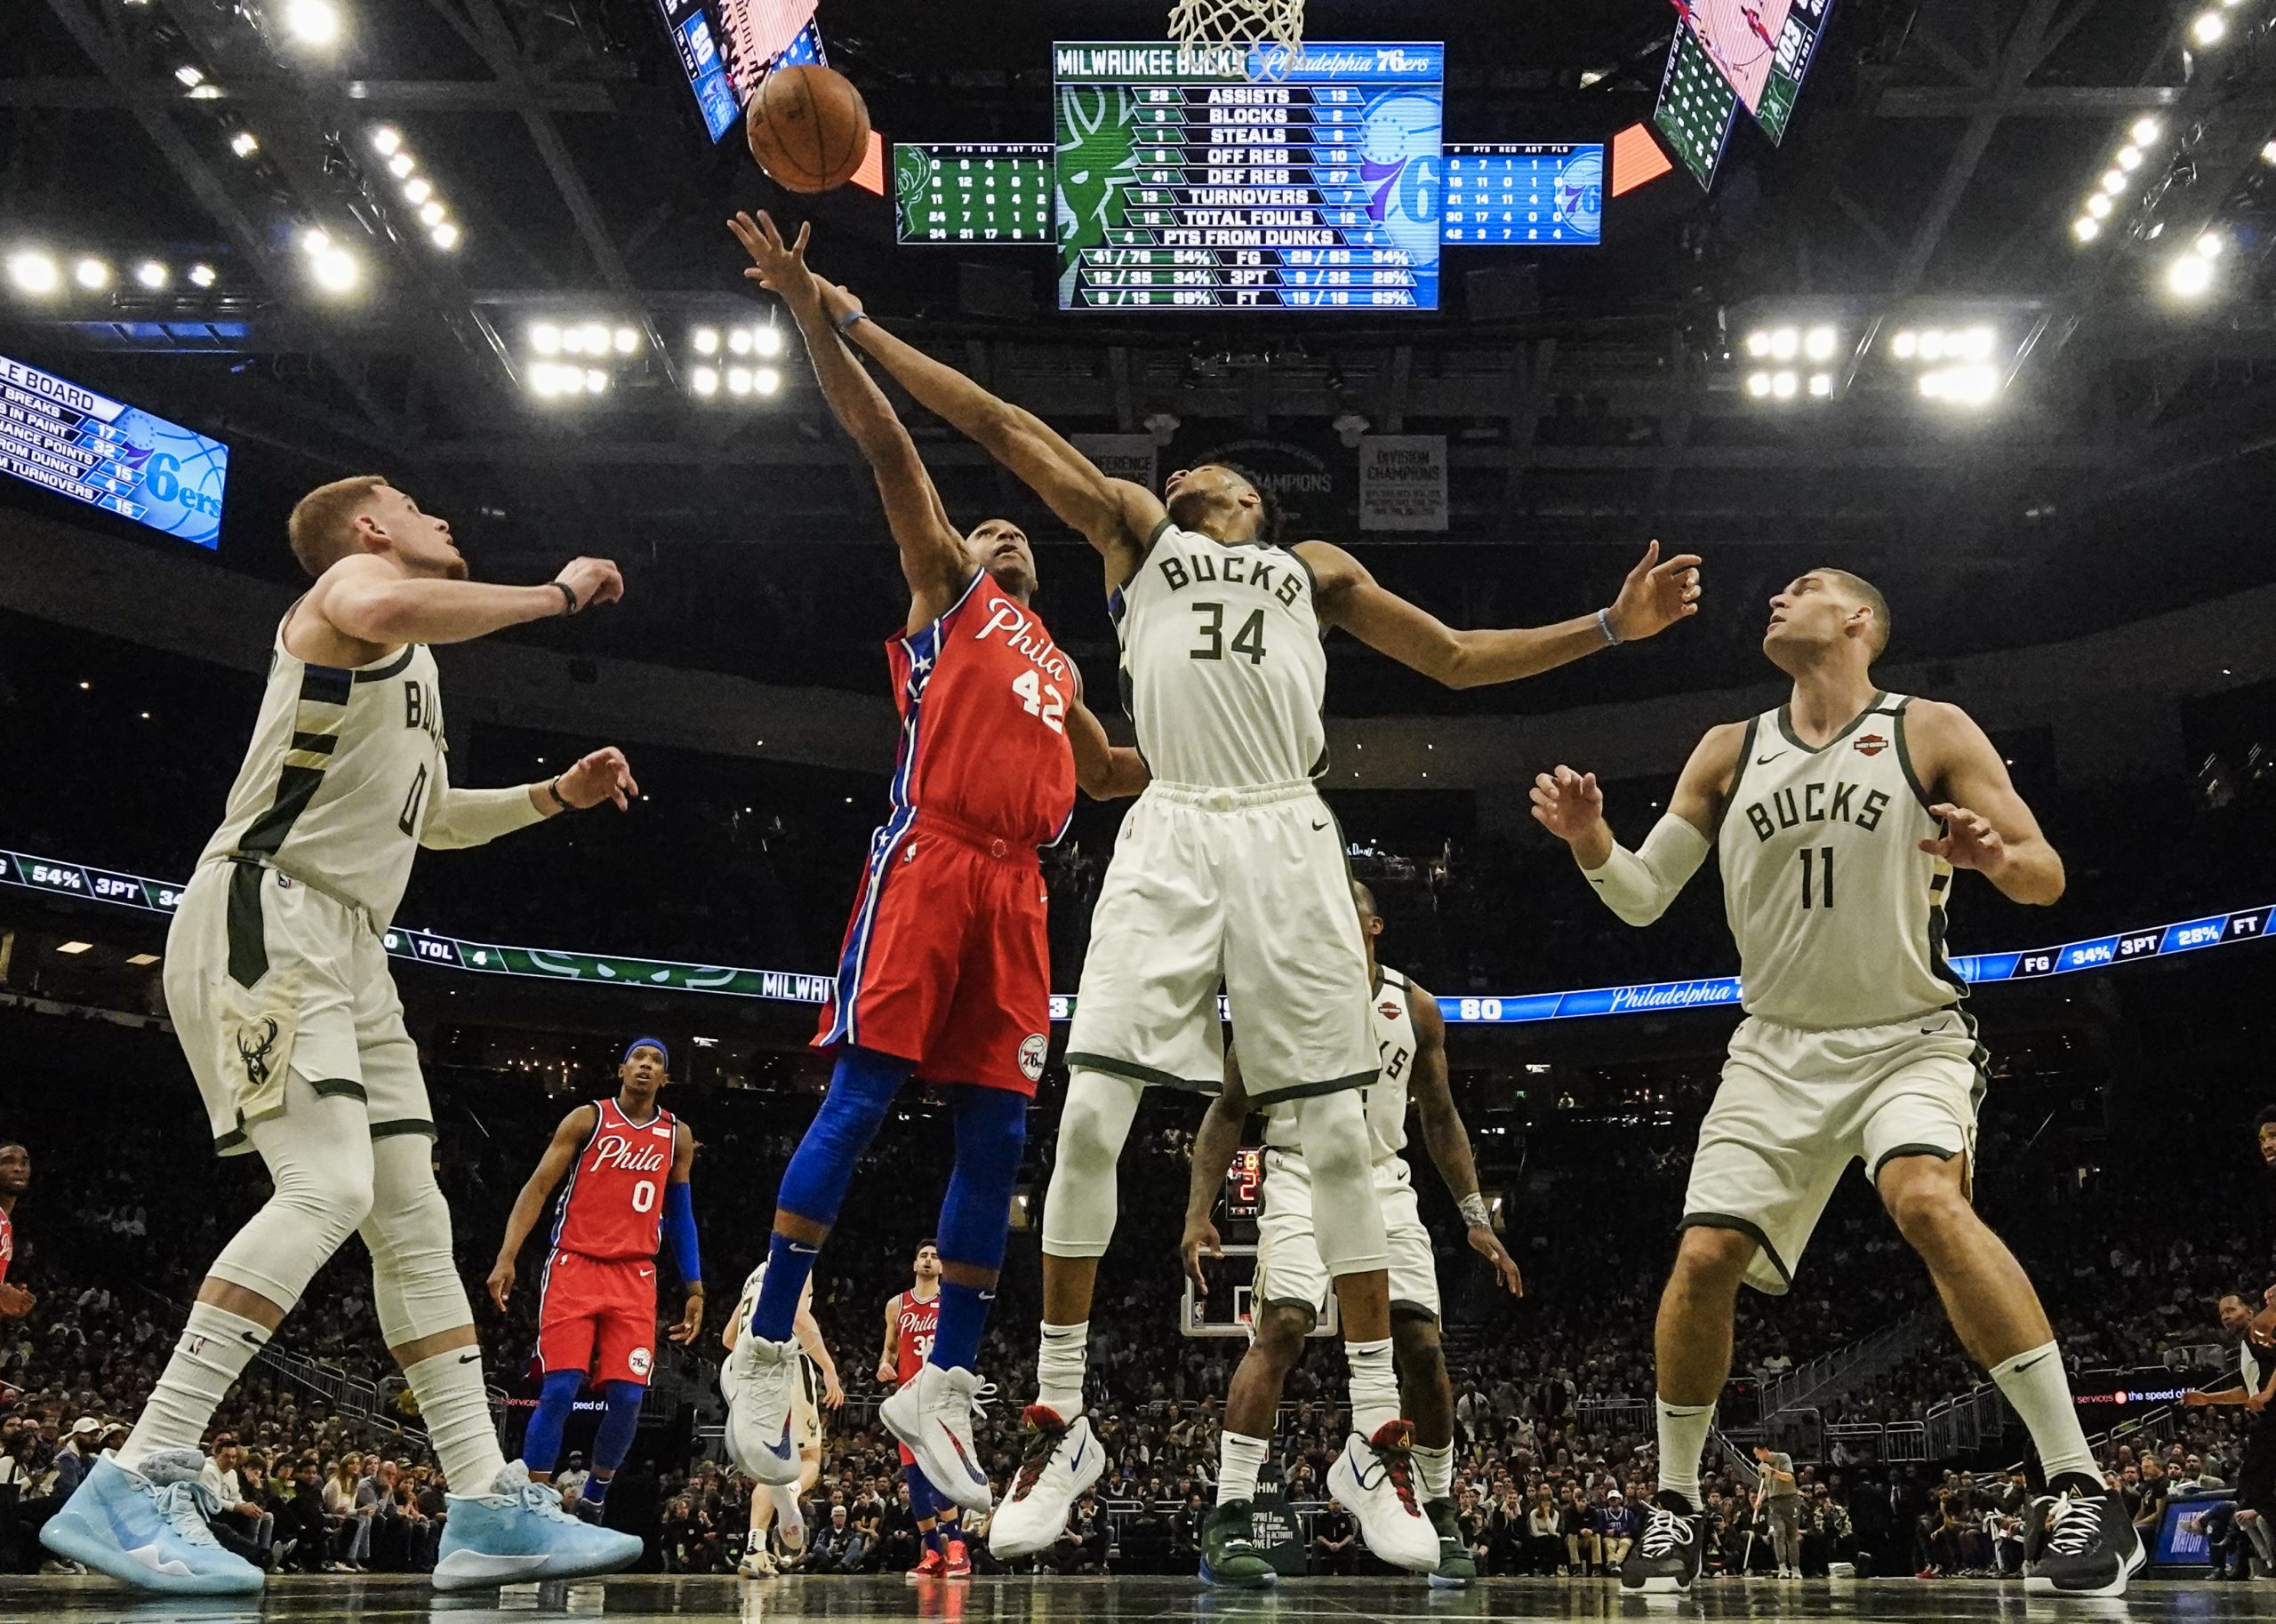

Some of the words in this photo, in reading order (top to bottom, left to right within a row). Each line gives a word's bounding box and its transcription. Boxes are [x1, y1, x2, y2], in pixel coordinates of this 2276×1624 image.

[691, 22, 715, 65] 80
[1775, 18, 1801, 73] 103
[1057, 50, 1173, 76] MILWAUKEE
[1377, 49, 1429, 72] 76ers
[1207, 89, 1289, 103] ASSISTS
[1330, 90, 1348, 101] 13
[1155, 109, 1166, 122] 3
[1209, 108, 1287, 124] BLOCKS
[1333, 109, 1342, 122] 2
[1157, 130, 1164, 141] 1
[1211, 128, 1286, 143] STEALS
[1207, 148, 1245, 164] OFF
[1249, 148, 1288, 164] REB
[1330, 150, 1347, 162] 10
[931, 159, 941, 170] 0
[985, 159, 994, 170] 4
[1012, 159, 1019, 170] 1
[1038, 159, 1044, 170] 1
[1450, 159, 1460, 170] 0
[1479, 159, 1487, 170] 7
[1505, 159, 1511, 170] 1
[1531, 159, 1538, 170] 1
[1556, 159, 1563, 170] 1
[958, 177, 973, 188] 12
[985, 177, 995, 188] 4
[1038, 177, 1044, 188] 1
[1151, 171, 1168, 182] 41
[1207, 169, 1245, 184] DEF
[1250, 169, 1289, 184] REB
[1330, 171, 1348, 182] 27
[1477, 177, 1488, 188] 11
[1503, 177, 1513, 188] 0
[1531, 177, 1537, 188] 1
[931, 194, 942, 204] 11
[962, 194, 970, 204] 7
[1012, 194, 1021, 204] 4
[1037, 194, 1046, 204] 2
[1141, 191, 1158, 203] 13
[1189, 189, 1309, 204] TURNOVERS
[1342, 191, 1352, 203] 7
[1447, 194, 1462, 204] 21
[1475, 194, 1489, 204] 14
[1502, 194, 1512, 204] 11
[1529, 194, 1538, 204] 4
[929, 211, 946, 222] 24
[962, 211, 971, 222] 7
[988, 211, 994, 222] 1
[1014, 211, 1020, 222] 1
[1037, 211, 1046, 222] 0
[1143, 212, 1159, 224] 12
[1183, 211, 1247, 226] TOTAL
[1250, 211, 1313, 226] FOULS
[1340, 212, 1356, 224] 12
[1446, 211, 1463, 222] 30
[1475, 211, 1488, 222] 17
[1503, 211, 1511, 222] 4
[1528, 211, 1538, 222] 0
[929, 228, 947, 239] 34
[959, 228, 974, 239] 31
[984, 228, 998, 239] 17
[1038, 228, 1046, 239] 1
[1124, 231, 1134, 244] 4
[1164, 230, 1200, 245] PTS
[1206, 230, 1260, 245] FROM
[1266, 230, 1334, 245] DUNKS
[1363, 231, 1374, 244] 4
[1446, 228, 1463, 239] 42
[1477, 228, 1487, 239] 3
[1503, 228, 1511, 239] 7
[1528, 228, 1537, 239] 2
[1553, 228, 1562, 239] 4
[1093, 251, 1111, 263] 41
[1174, 251, 1210, 265] 54%
[1237, 251, 1261, 265] FG
[1372, 251, 1408, 265] 34%
[1094, 271, 1112, 284] 12
[1130, 271, 1152, 284] 35
[1174, 271, 1210, 285] 34%
[1230, 270, 1267, 284] 3PT
[1328, 271, 1350, 284] 32
[1132, 292, 1150, 304] 13
[1237, 292, 1260, 305] FT
[1292, 292, 1310, 304] 15
[26, 370, 94, 412] BOARD
[5, 388, 60, 418] BREAKS
[9, 407, 25, 421] IN
[28, 413, 68, 437] PAINT
[98, 424, 116, 439] 17
[44, 437, 93, 465] POINTS
[93, 440, 116, 457] 32
[31, 450, 79, 476] DUNKS
[11, 460, 94, 500] TURNOVERS
[115, 465, 133, 481] 15
[104, 481, 116, 492] 4
[116, 499, 133, 514] 15
[1158, 555, 1303, 608] BUCKS
[974, 597, 1065, 682] Phila
[1190, 603, 1267, 665] 34
[1012, 668, 1064, 735] 42
[1745, 781, 1891, 843] BUCKS
[32, 865, 81, 889] 54%
[95, 877, 140, 899] 3PT
[1799, 846, 1834, 909] 11
[2024, 956, 2050, 972] FG
[2072, 945, 2112, 964] 34%
[2120, 935, 2158, 955] 3PT
[2178, 925, 2219, 946] 28%
[2233, 916, 2258, 934] FT
[418, 940, 453, 960] TOL
[472, 950, 487, 965] 4
[1460, 998, 1503, 1020] 80
[1609, 980, 1732, 1012] Philadelphia
[589, 1134, 664, 1172] Phila
[632, 1180, 655, 1213] 0
[2077, 1394, 2114, 1404] services
[2128, 1392, 2144, 1401] the
[2145, 1388, 2175, 1402] speed
[595, 1400, 605, 1411] of
